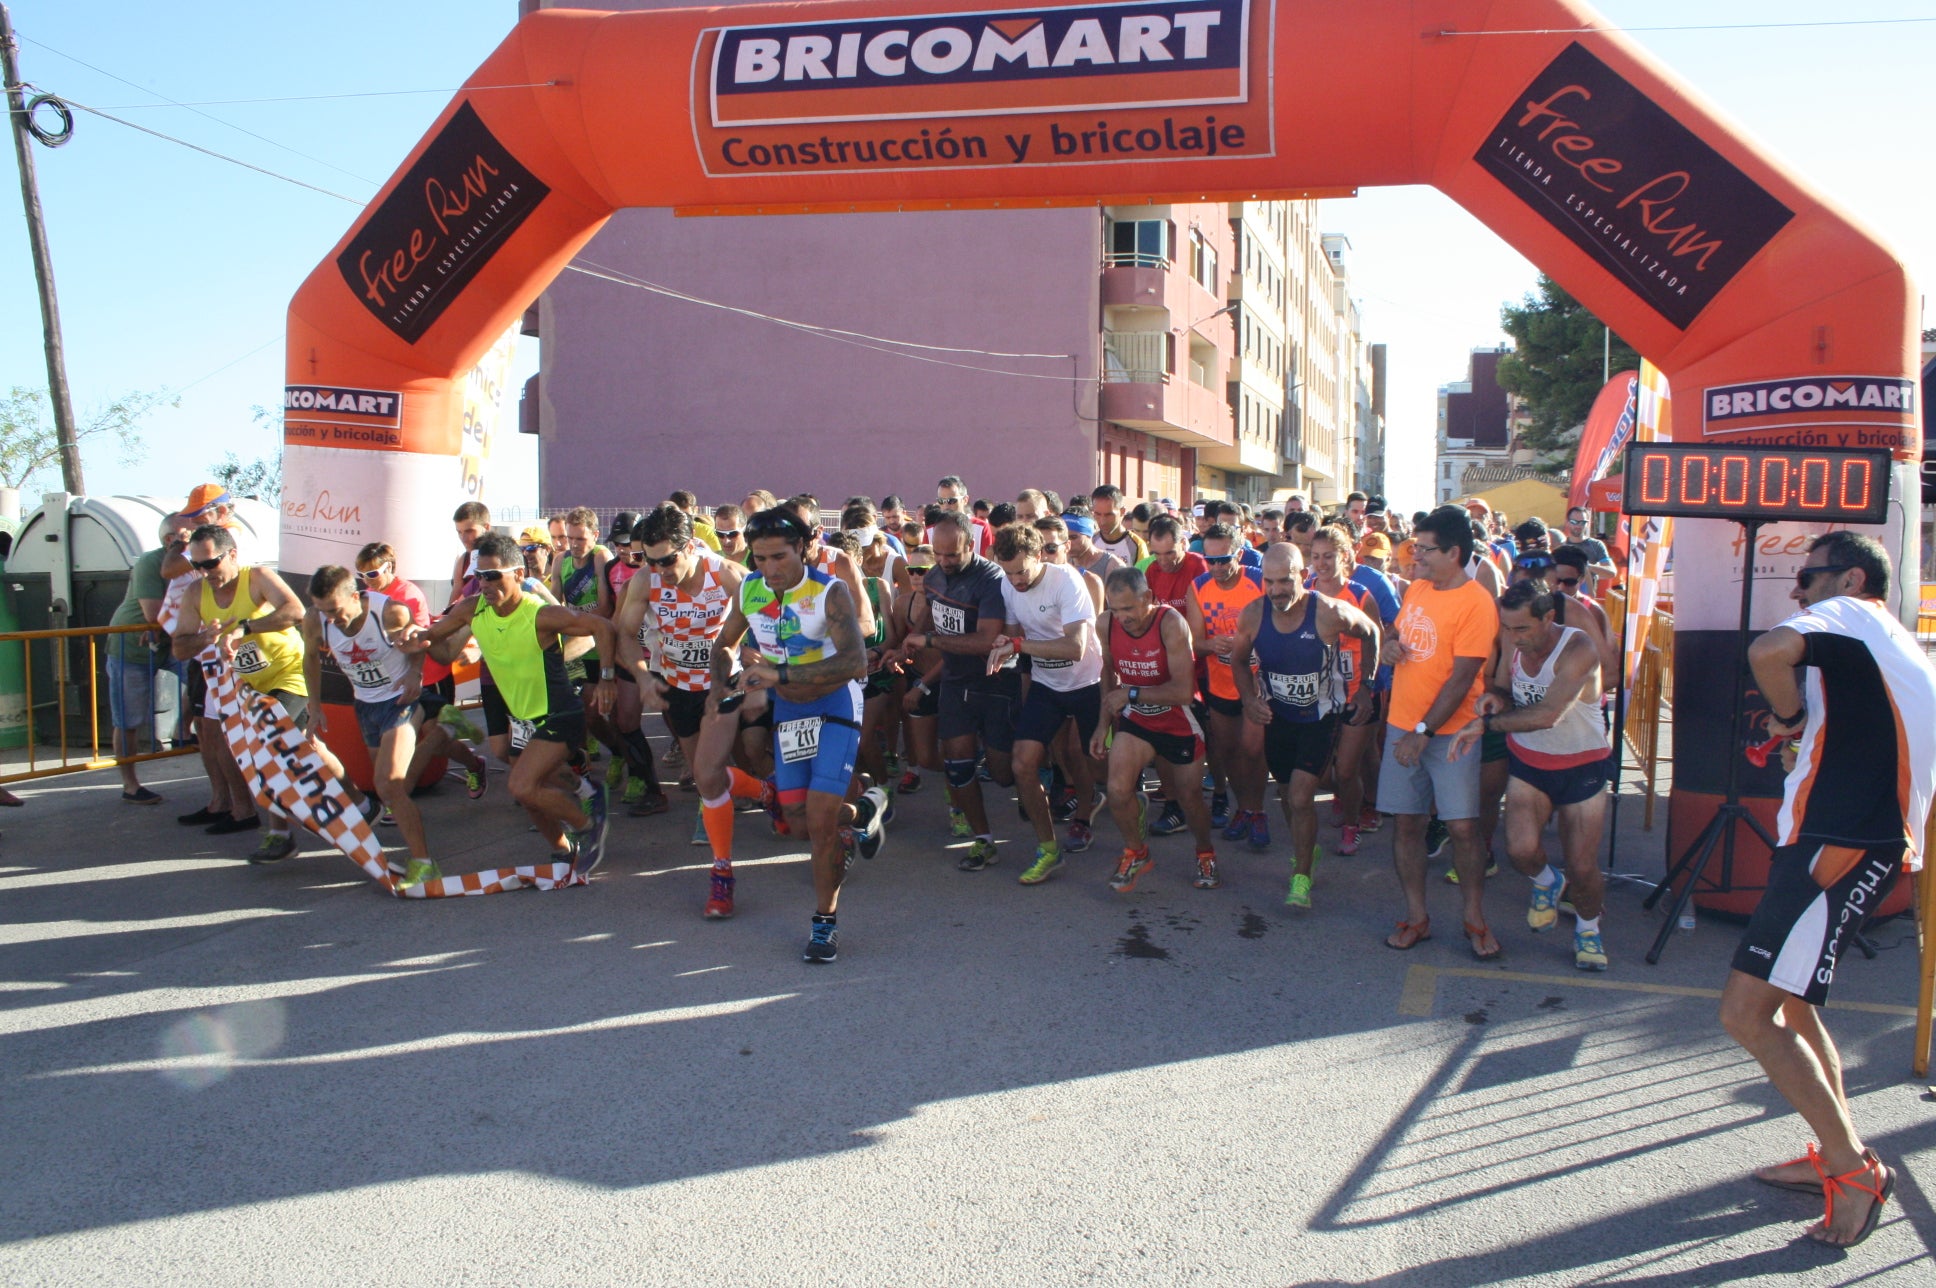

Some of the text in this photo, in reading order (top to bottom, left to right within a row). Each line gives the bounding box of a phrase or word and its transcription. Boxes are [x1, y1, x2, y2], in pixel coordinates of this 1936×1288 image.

[733, 11, 1221, 84] BRICOMART
[721, 116, 1246, 168] Construcción y bricolaje
[425, 154, 499, 236] Run
[1499, 137, 1687, 297] TIENDA ESPECIALIZADA
[1616, 170, 1723, 272] Run
[393, 183, 519, 324] TIENDA ESPECIALIZADA
[285, 391, 393, 414] RICOMART
[1711, 384, 1912, 417] BRICOMART
[321, 428, 328, 440] y
[334, 426, 398, 445] bricolaje
[1837, 434, 1849, 446] y
[1641, 454, 1871, 510] 00:00:00
[658, 607, 724, 618] Burriana
[942, 614, 961, 633] 381
[236, 649, 259, 668] 237
[682, 648, 710, 662] 278
[1119, 659, 1159, 670] ATLETISME
[357, 667, 383, 682] 271
[1286, 683, 1315, 698] 244
[795, 728, 816, 748] 211
